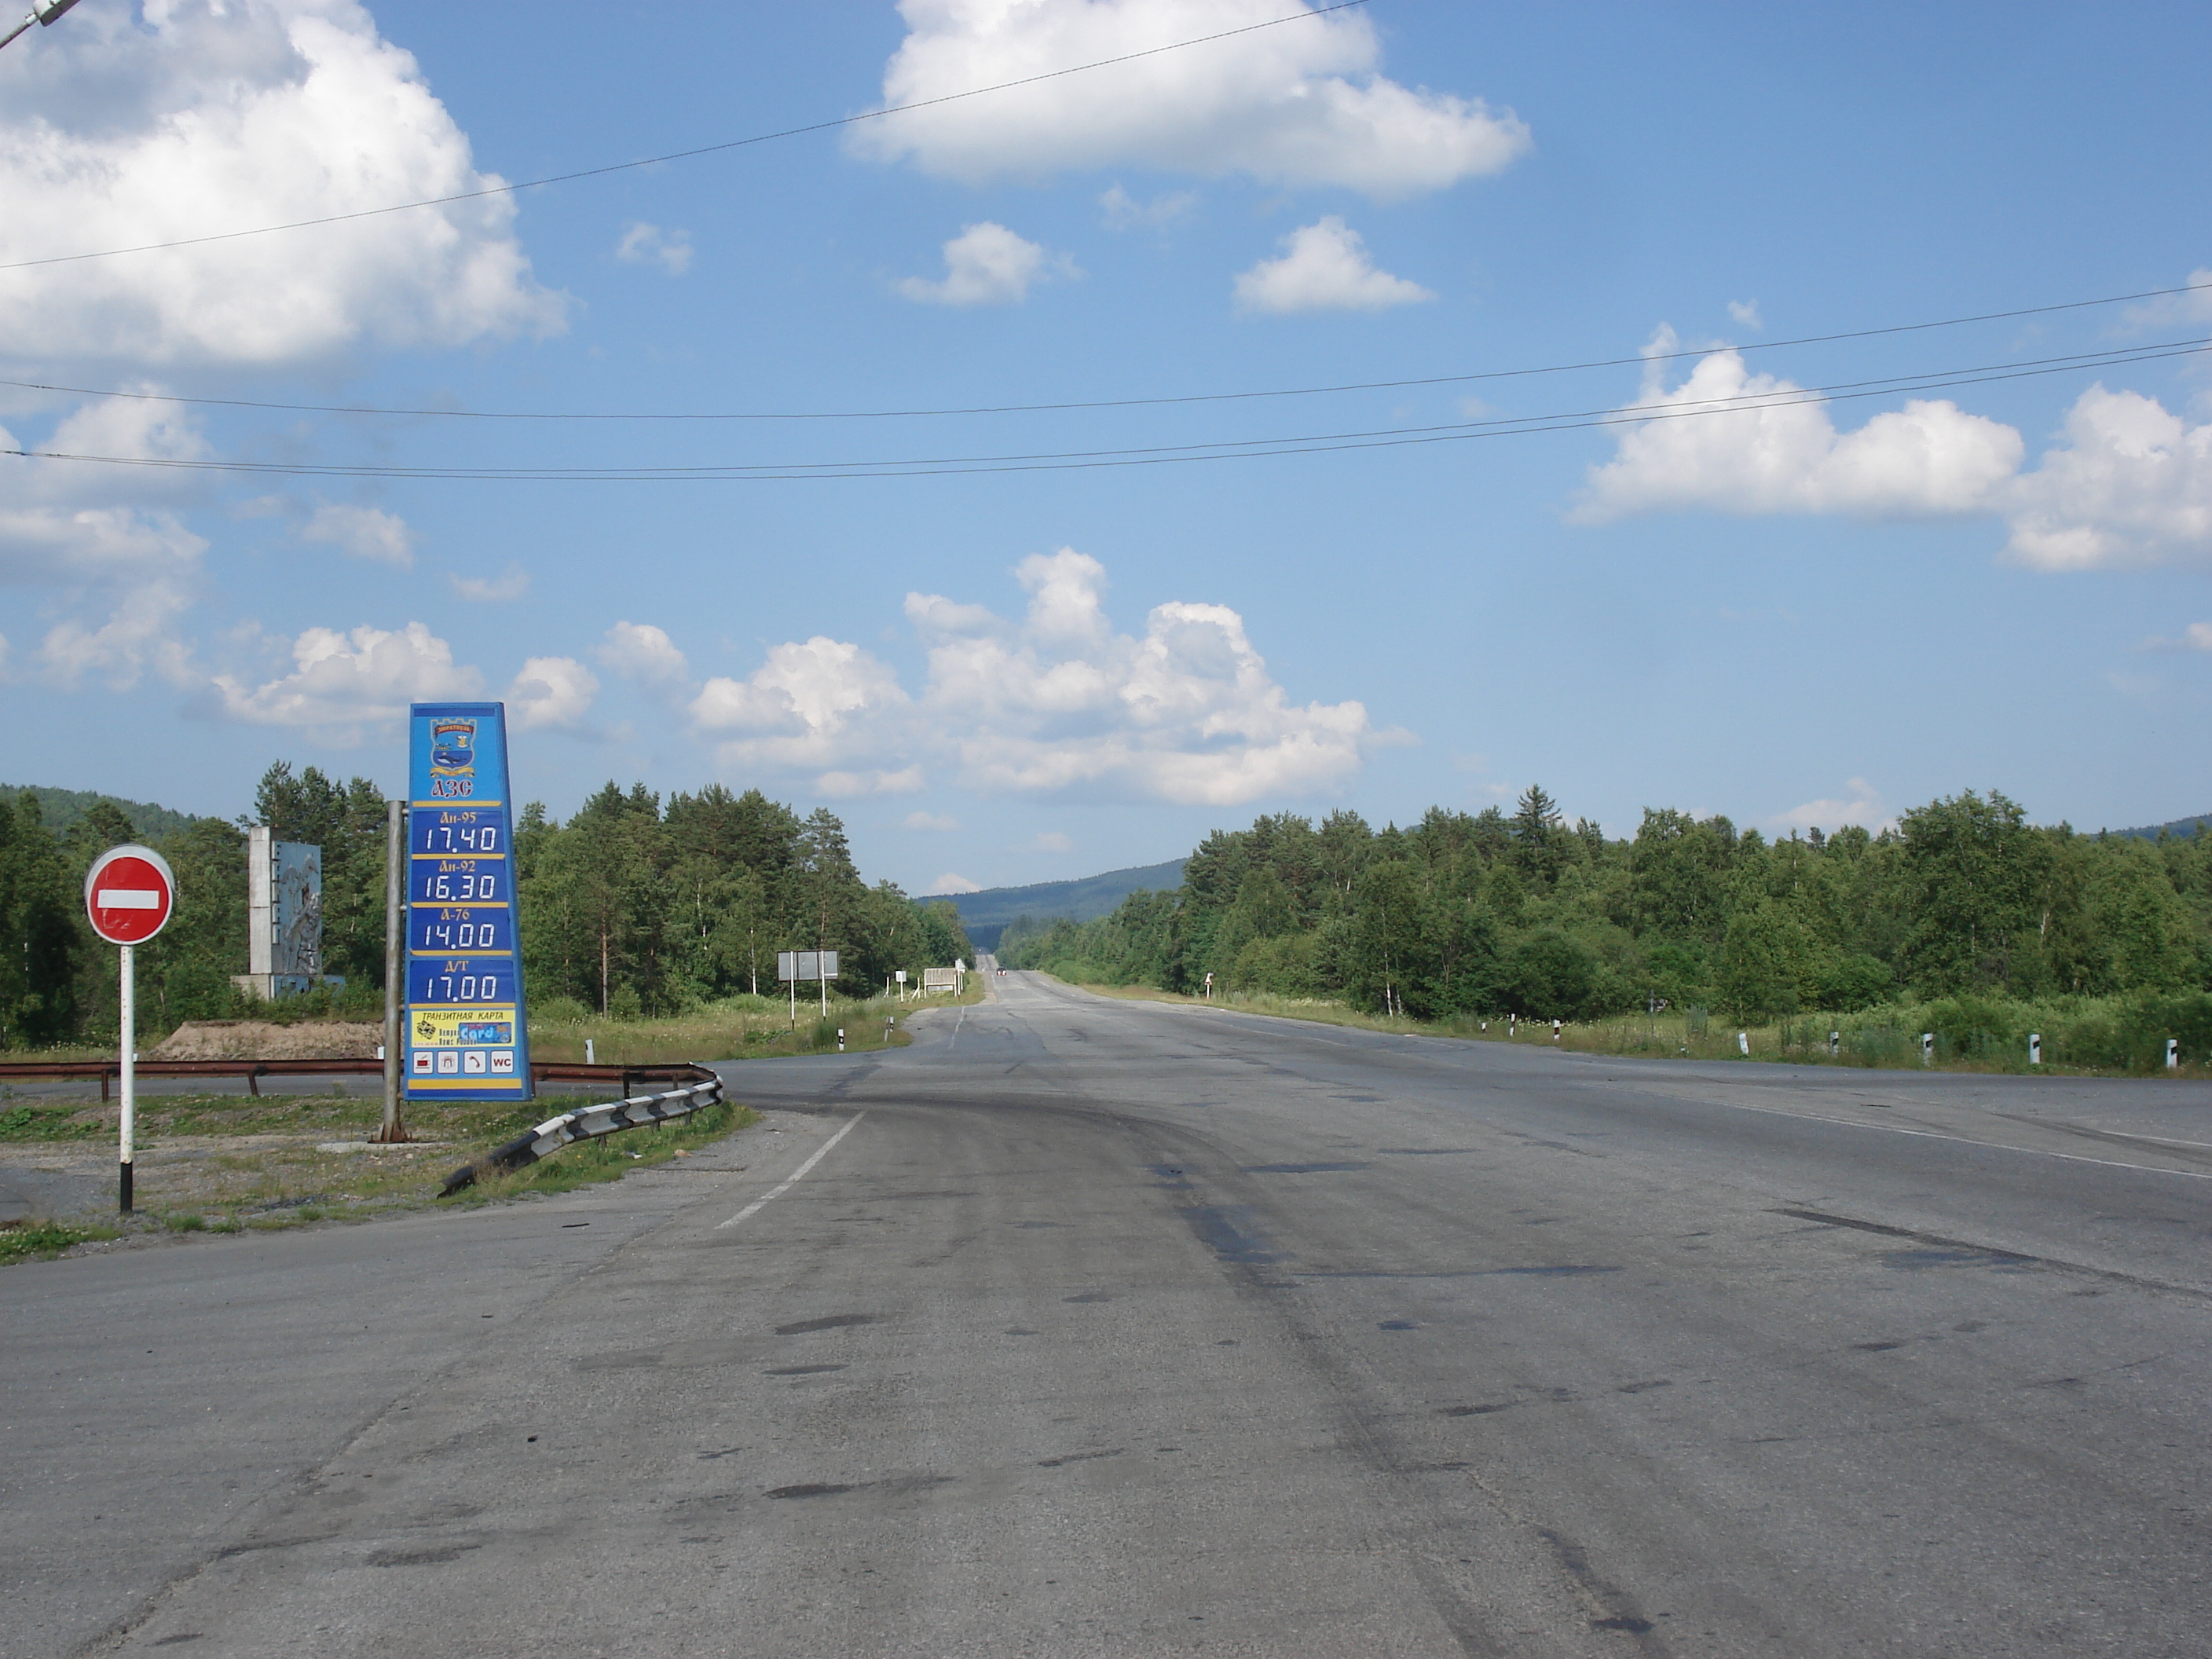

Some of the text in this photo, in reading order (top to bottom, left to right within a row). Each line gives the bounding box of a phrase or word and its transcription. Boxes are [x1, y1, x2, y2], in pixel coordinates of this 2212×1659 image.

[432, 780, 473, 799] АЗС
[427, 827, 496, 853] 17.40
[427, 875, 495, 901] 16.30
[441, 908, 470, 921] А-76
[426, 924, 494, 949] 14.00
[445, 961, 469, 972] Д/Т
[428, 976, 496, 1002] 17.00
[423, 1012, 474, 1020] ТРАНЗИТНАЯ
[460, 1027, 494, 1040] Card
